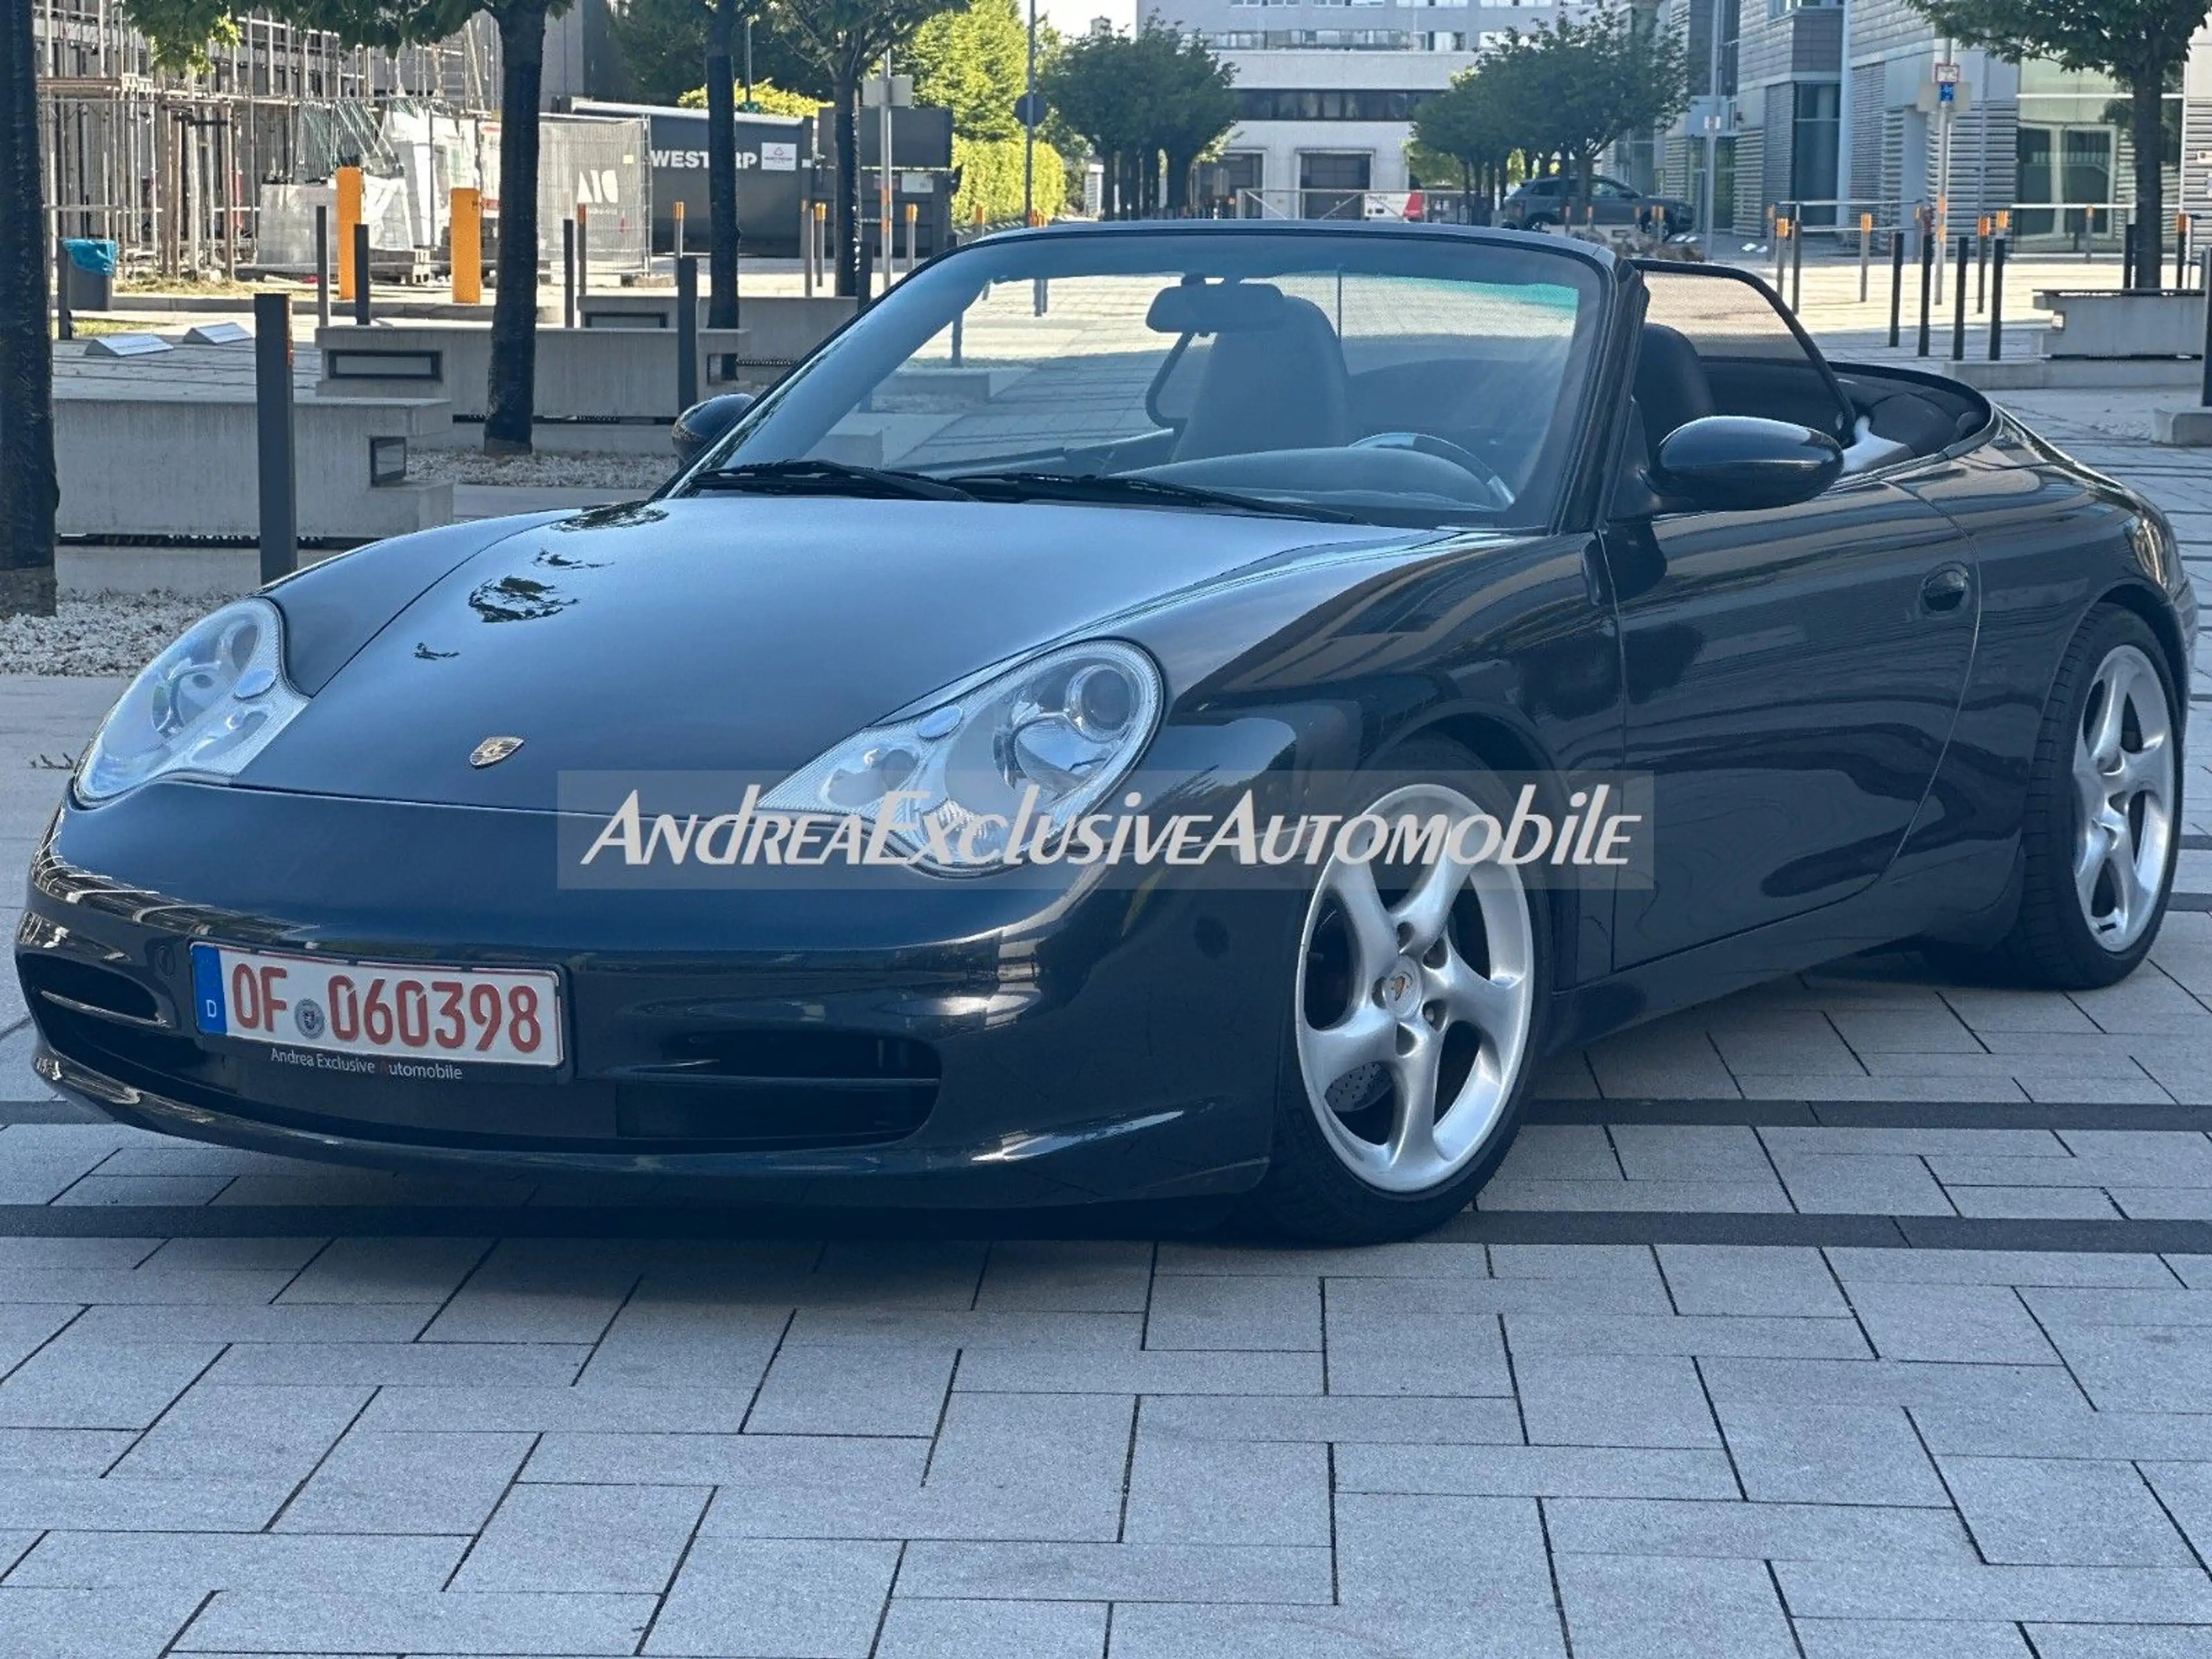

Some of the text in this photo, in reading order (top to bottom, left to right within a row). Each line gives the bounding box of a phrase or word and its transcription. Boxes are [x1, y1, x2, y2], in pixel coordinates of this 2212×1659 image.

[206, 999, 217, 1017] D
[232, 963, 288, 1032] OF
[328, 975, 542, 1053] 060398
[270, 1047, 315, 1067] Andrea
[316, 1054, 376, 1074] Exclusive
